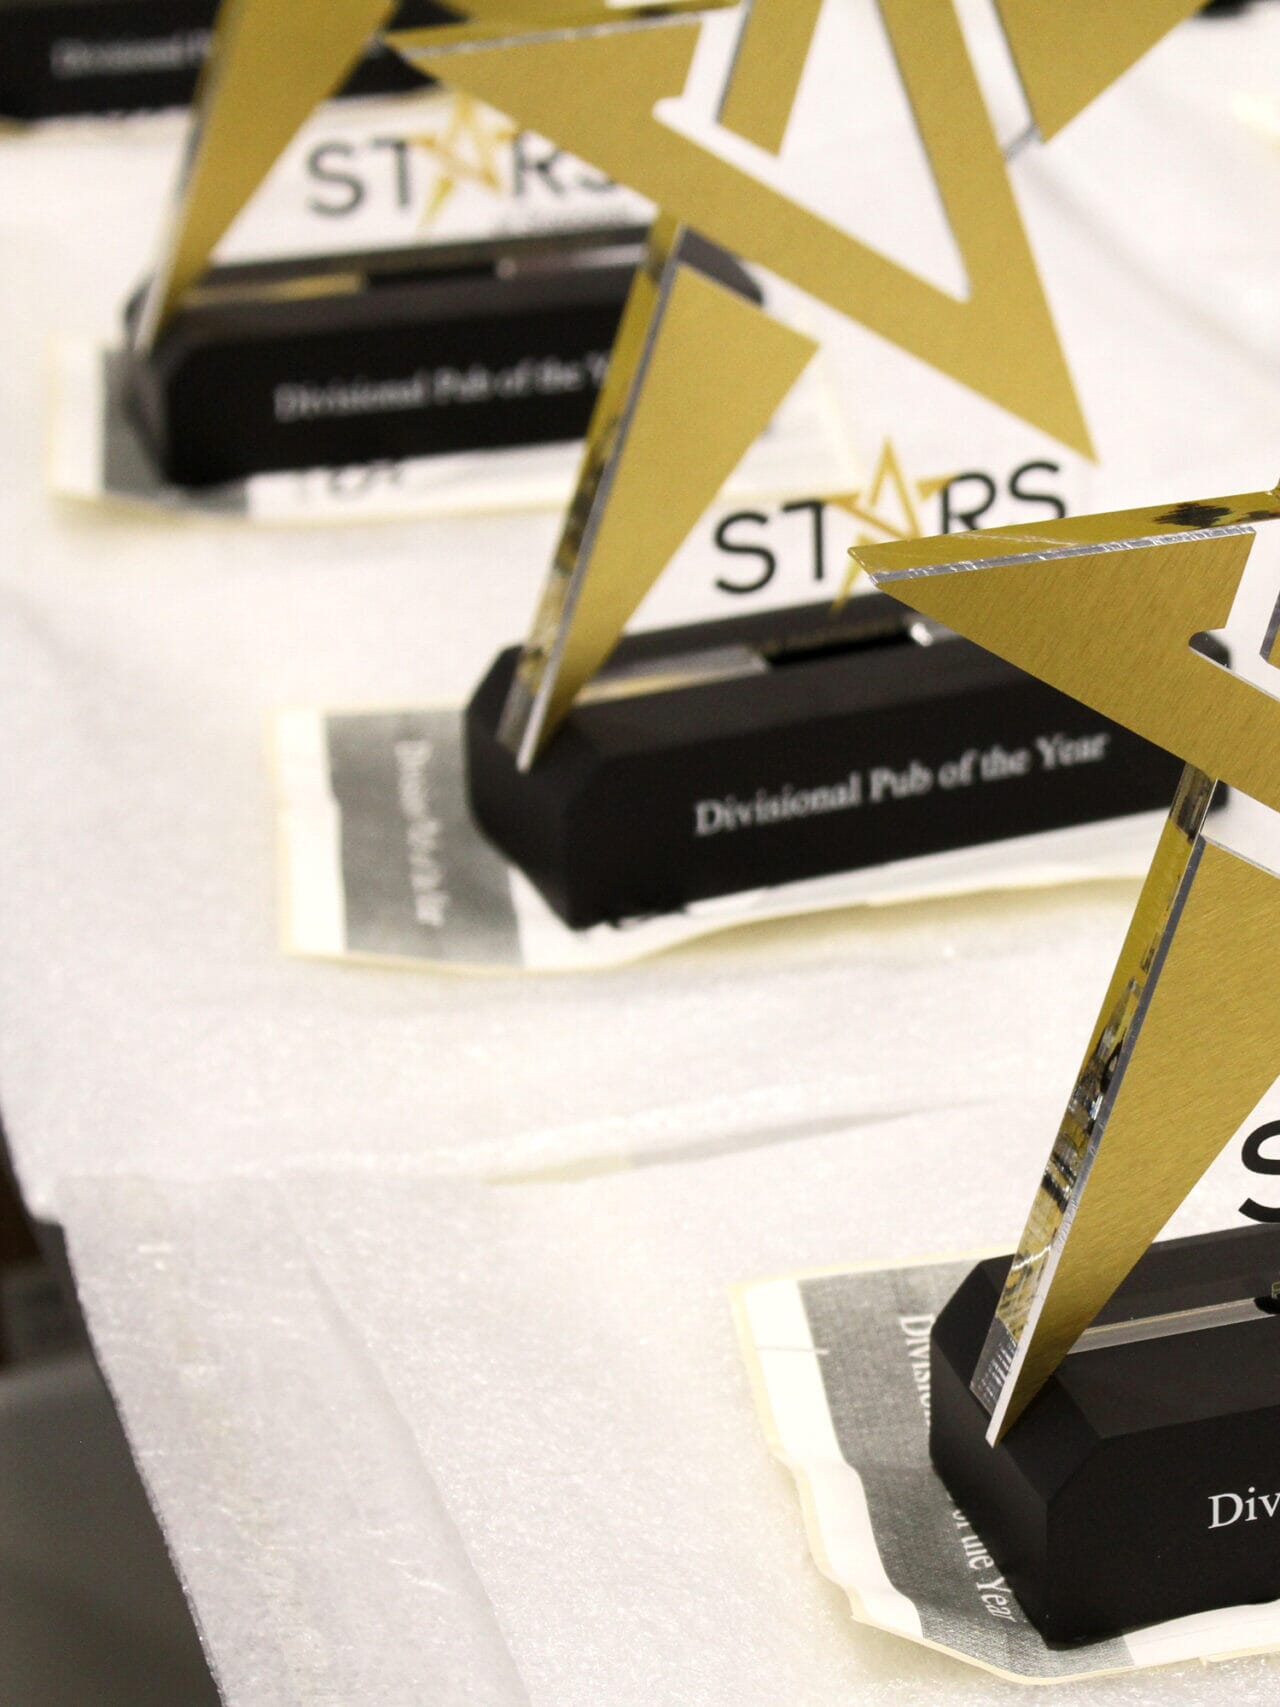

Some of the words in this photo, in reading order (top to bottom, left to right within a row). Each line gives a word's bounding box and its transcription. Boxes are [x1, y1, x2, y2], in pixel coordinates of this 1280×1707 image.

[304, 97, 615, 230] STAR
[695, 771, 862, 837] Divisional
[870, 759, 934, 803] Pub
[938, 749, 982, 789] of
[981, 745, 1032, 782] the
[1035, 732, 1111, 770] Year
[976, 1574, 1018, 1623] Year
